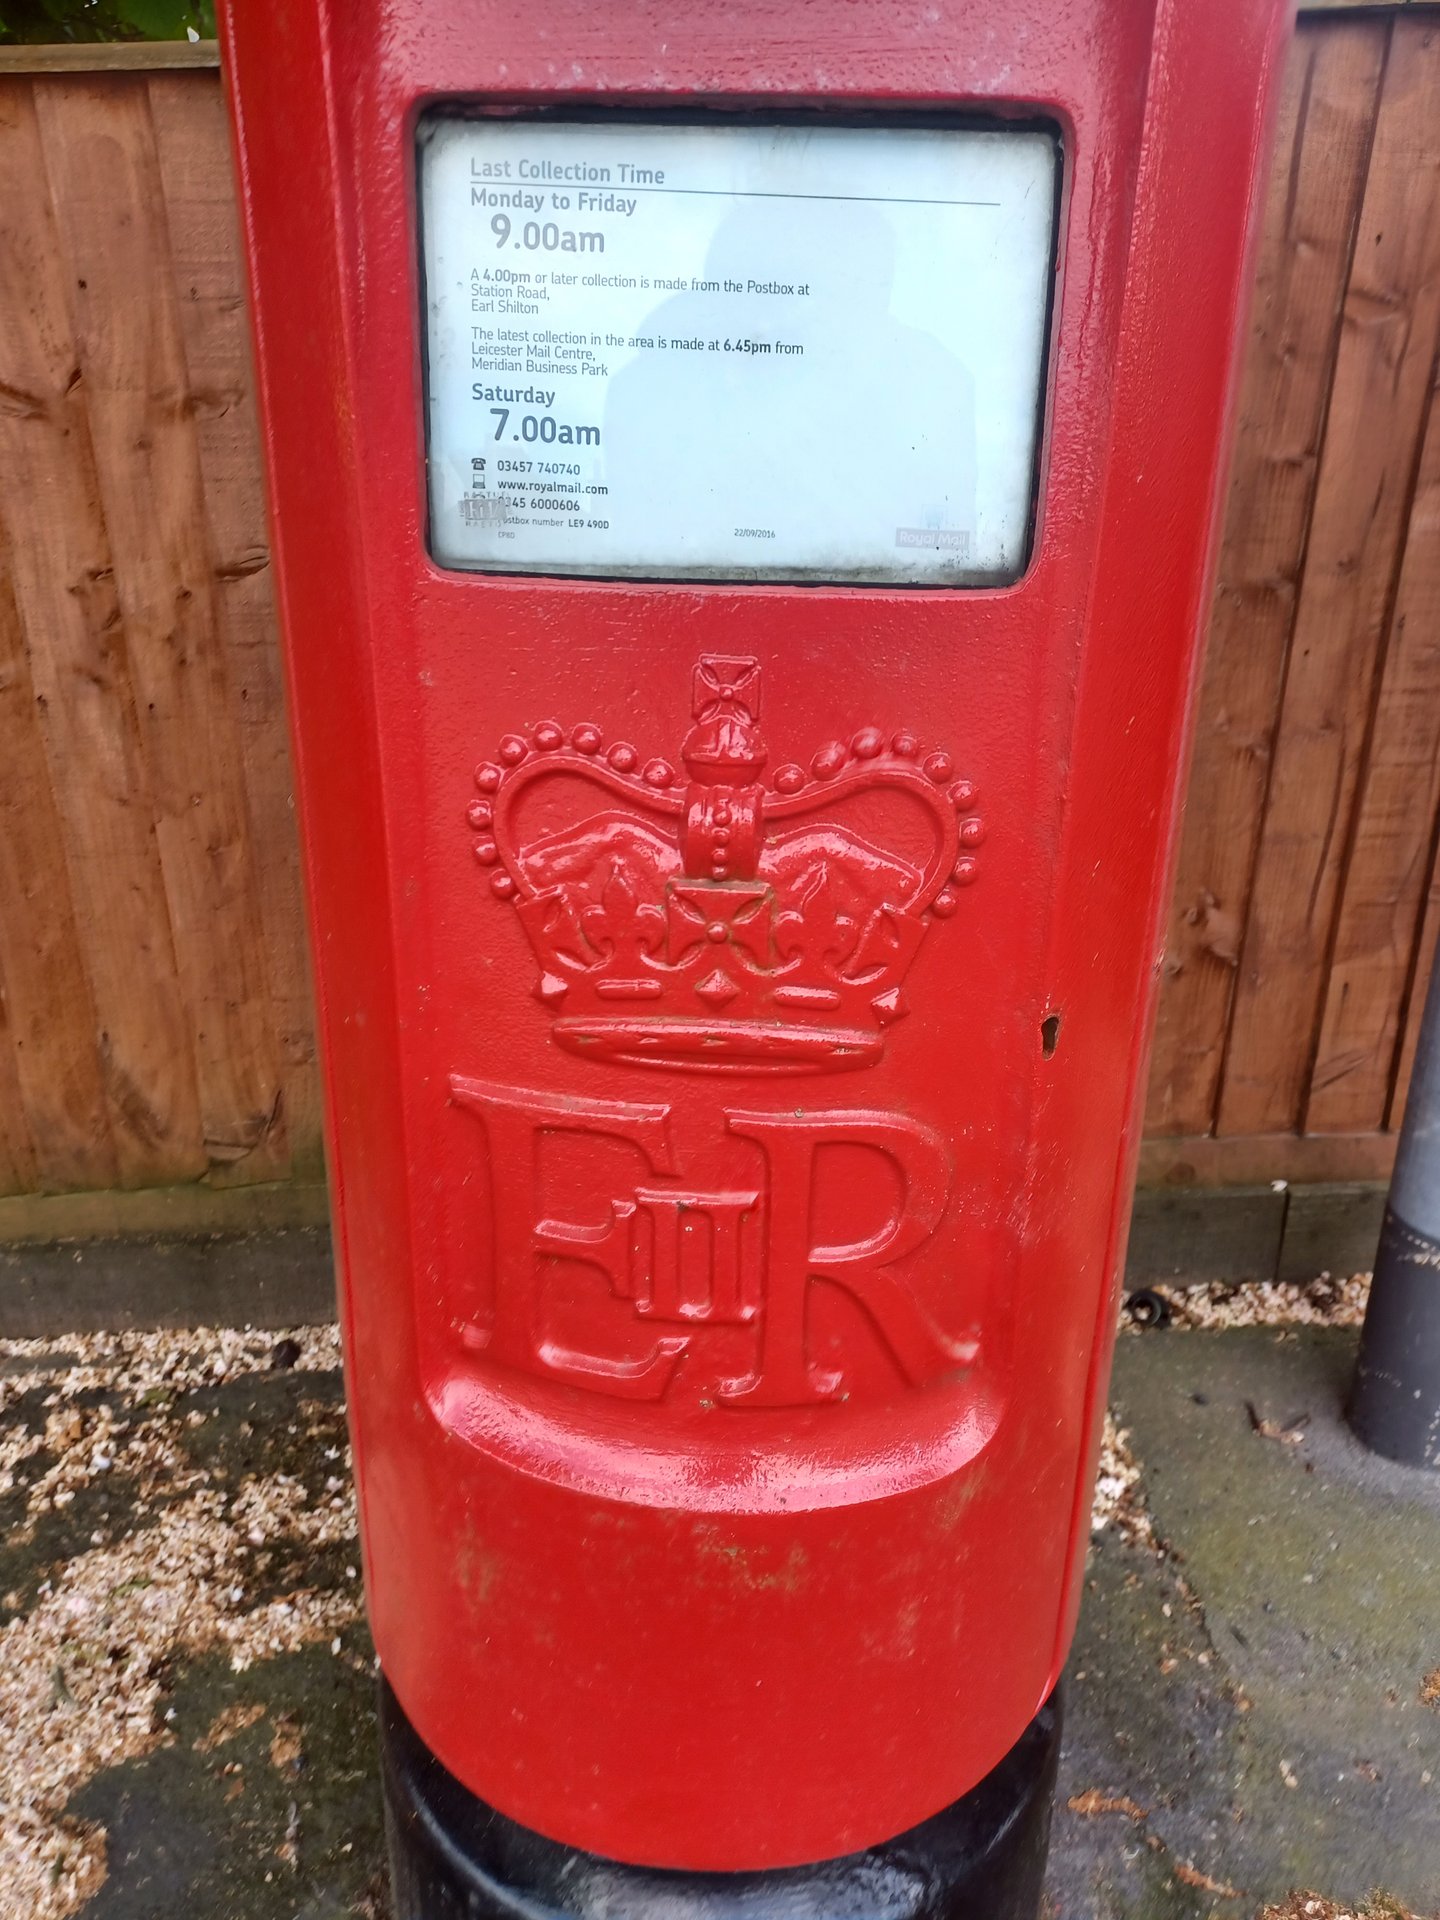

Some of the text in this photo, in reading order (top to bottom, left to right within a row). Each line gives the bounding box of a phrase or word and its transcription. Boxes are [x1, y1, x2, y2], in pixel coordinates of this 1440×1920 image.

[470, 158, 665, 184] Last Collection Time
[471, 188, 637, 216] Monday to Friday
[490, 213, 605, 253] 9.00am
[471, 268, 810, 295] A 4.00pm or later collection is made from the Postbox at
[471, 284, 550, 300] Station Road,
[472, 301, 539, 314] Earl Shilton
[472, 327, 804, 356] The latest collection in the area is made at 6.45pm from
[472, 342, 596, 361] Leicester Mail Centre,
[472, 358, 609, 376] Meridian Business Park
[472, 383, 556, 407] Saturday
[490, 408, 601, 446] 7.00am
[498, 460, 580, 475] 03457 740740
[498, 480, 608, 495] www.royalmail.com
[531, 498, 580, 511] 6000606
[532, 518, 564, 527] number
[568, 519, 584, 528] LE9
[734, 528, 776, 539] 22/09/2016
[899, 530, 966, 546] Royal Mail
